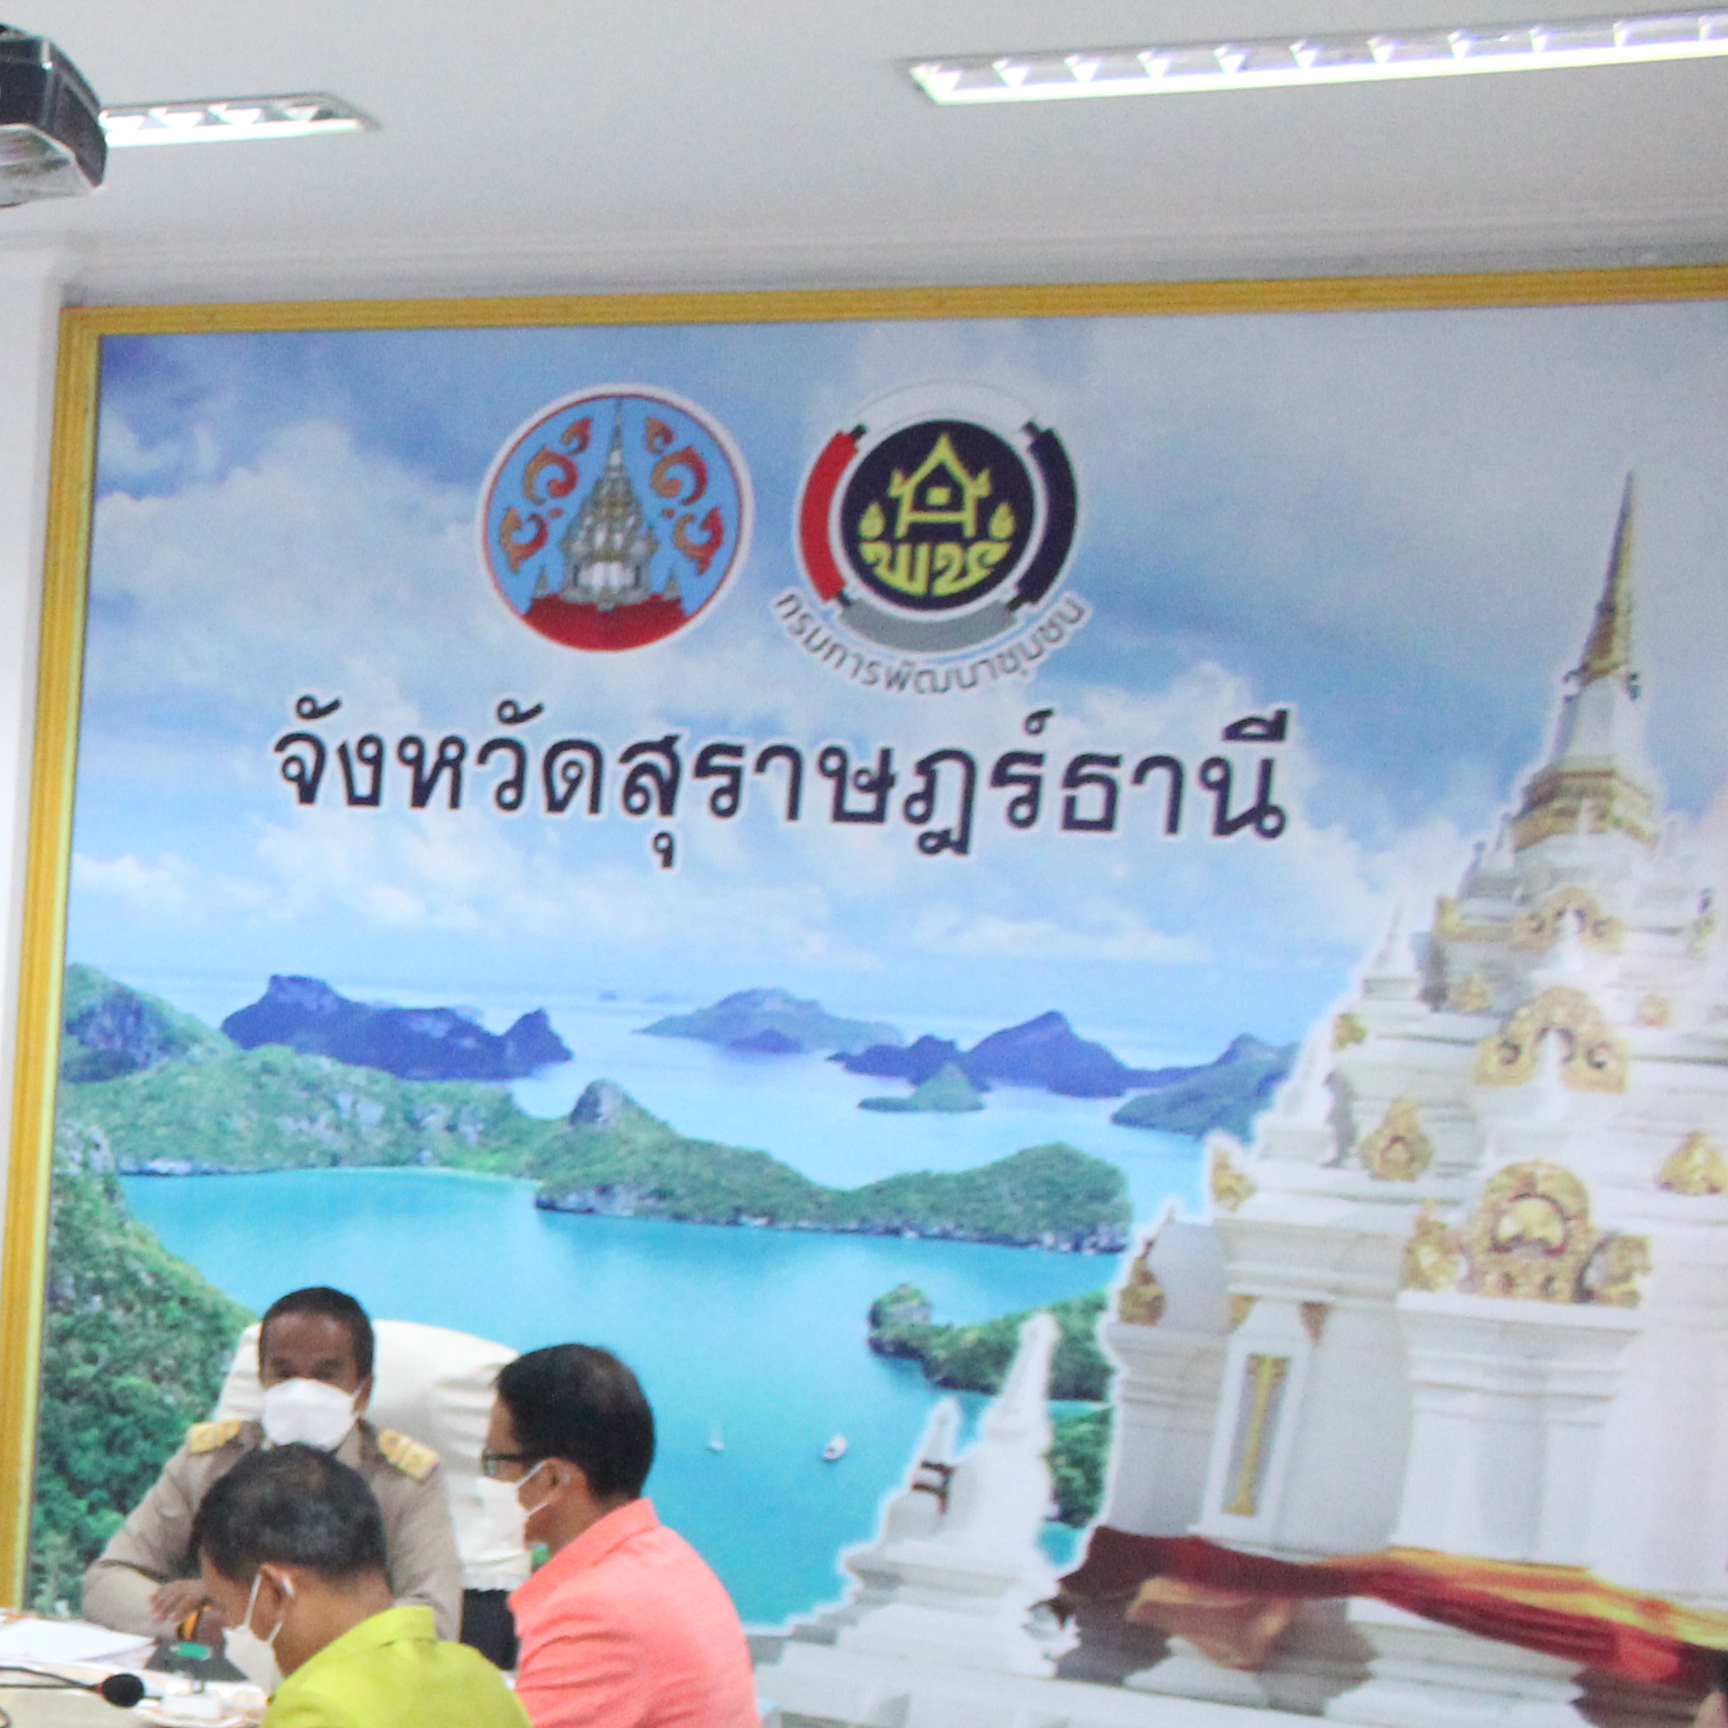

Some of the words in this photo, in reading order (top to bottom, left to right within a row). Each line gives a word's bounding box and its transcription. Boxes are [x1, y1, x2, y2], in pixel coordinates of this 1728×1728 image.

[776, 593, 1086, 694] กรมการพัฒนาชุมชน
[275, 696, 1287, 868] จังหวัดสุราษฎร์ธานี
